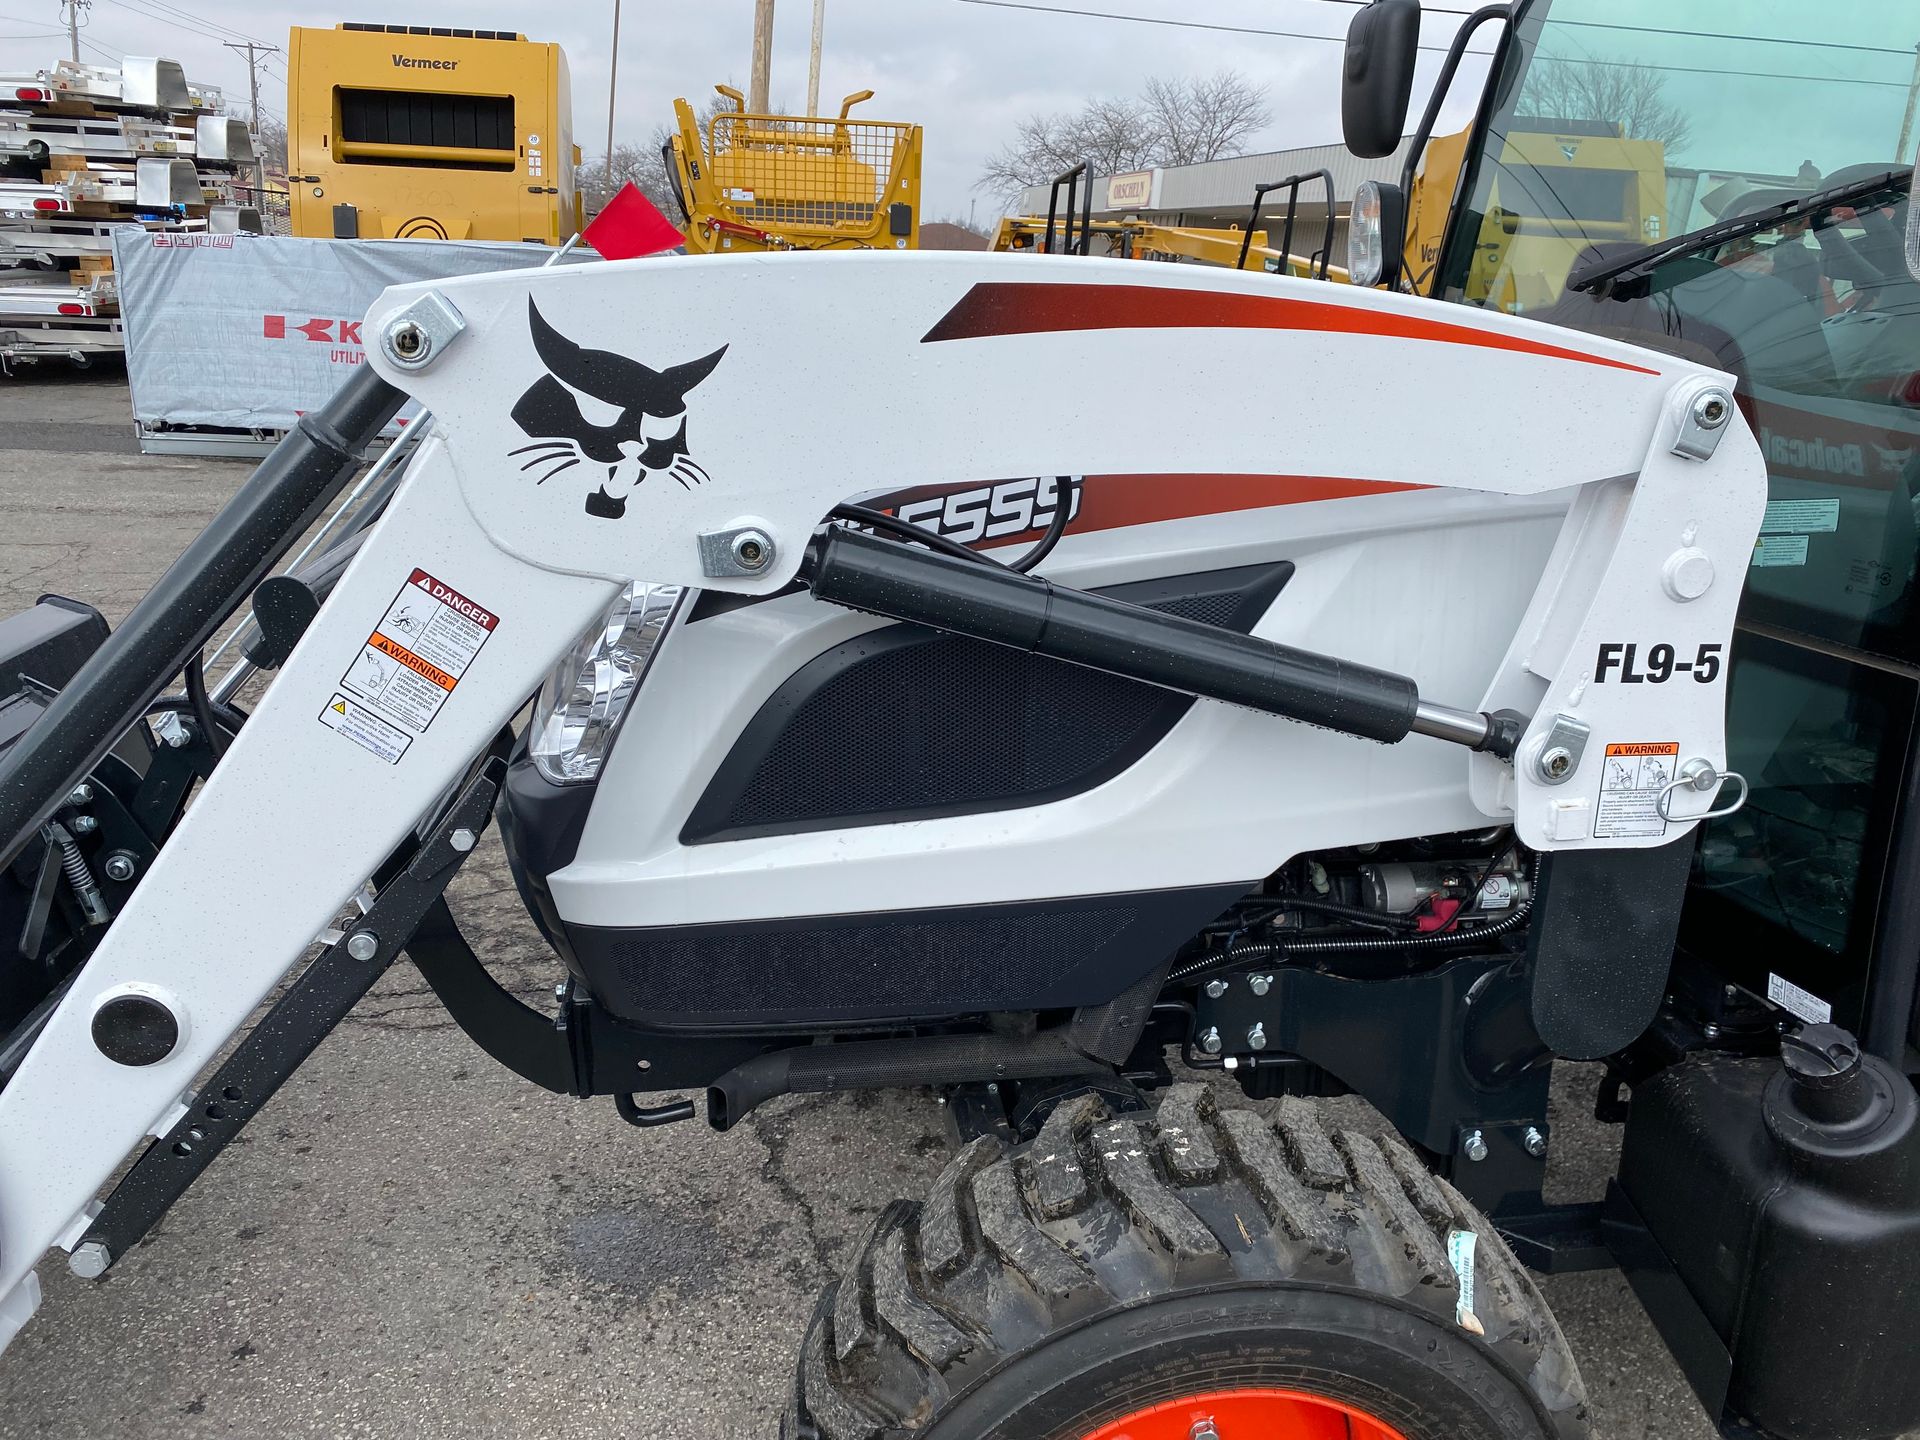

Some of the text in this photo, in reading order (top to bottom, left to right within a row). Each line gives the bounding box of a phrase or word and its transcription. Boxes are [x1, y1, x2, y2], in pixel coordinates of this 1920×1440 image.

[392, 54, 458, 70] Vermeer
[1114, 181, 1145, 200] ORSCHELN
[330, 349, 365, 364] UTILIT
[431, 584, 490, 626] DANGER
[438, 614, 456, 627] INJURY
[463, 630, 479, 641] DEATH
[443, 611, 480, 636] CAUSE SERIOUS
[446, 607, 483, 632] CRUSHING WILL
[388, 644, 449, 686] WARNING
[1594, 643, 1722, 683] FL9-5
[396, 676, 438, 703] ATTACHMENT CAN
[399, 671, 418, 685] LOADER
[419, 684, 433, 694] ARMS
[406, 669, 440, 692] FALLING FROM
[391, 685, 408, 698] INJURY
[415, 700, 431, 711] DEATH
[396, 682, 432, 706] CAUSE SERIOUS
[348, 712, 378, 732] Reproductive
[377, 729, 390, 739] Harm
[352, 723, 365, 732] more
[364, 729, 390, 746] information
[377, 722, 394, 734] Cancer
[1625, 745, 1671, 754] WARNING
